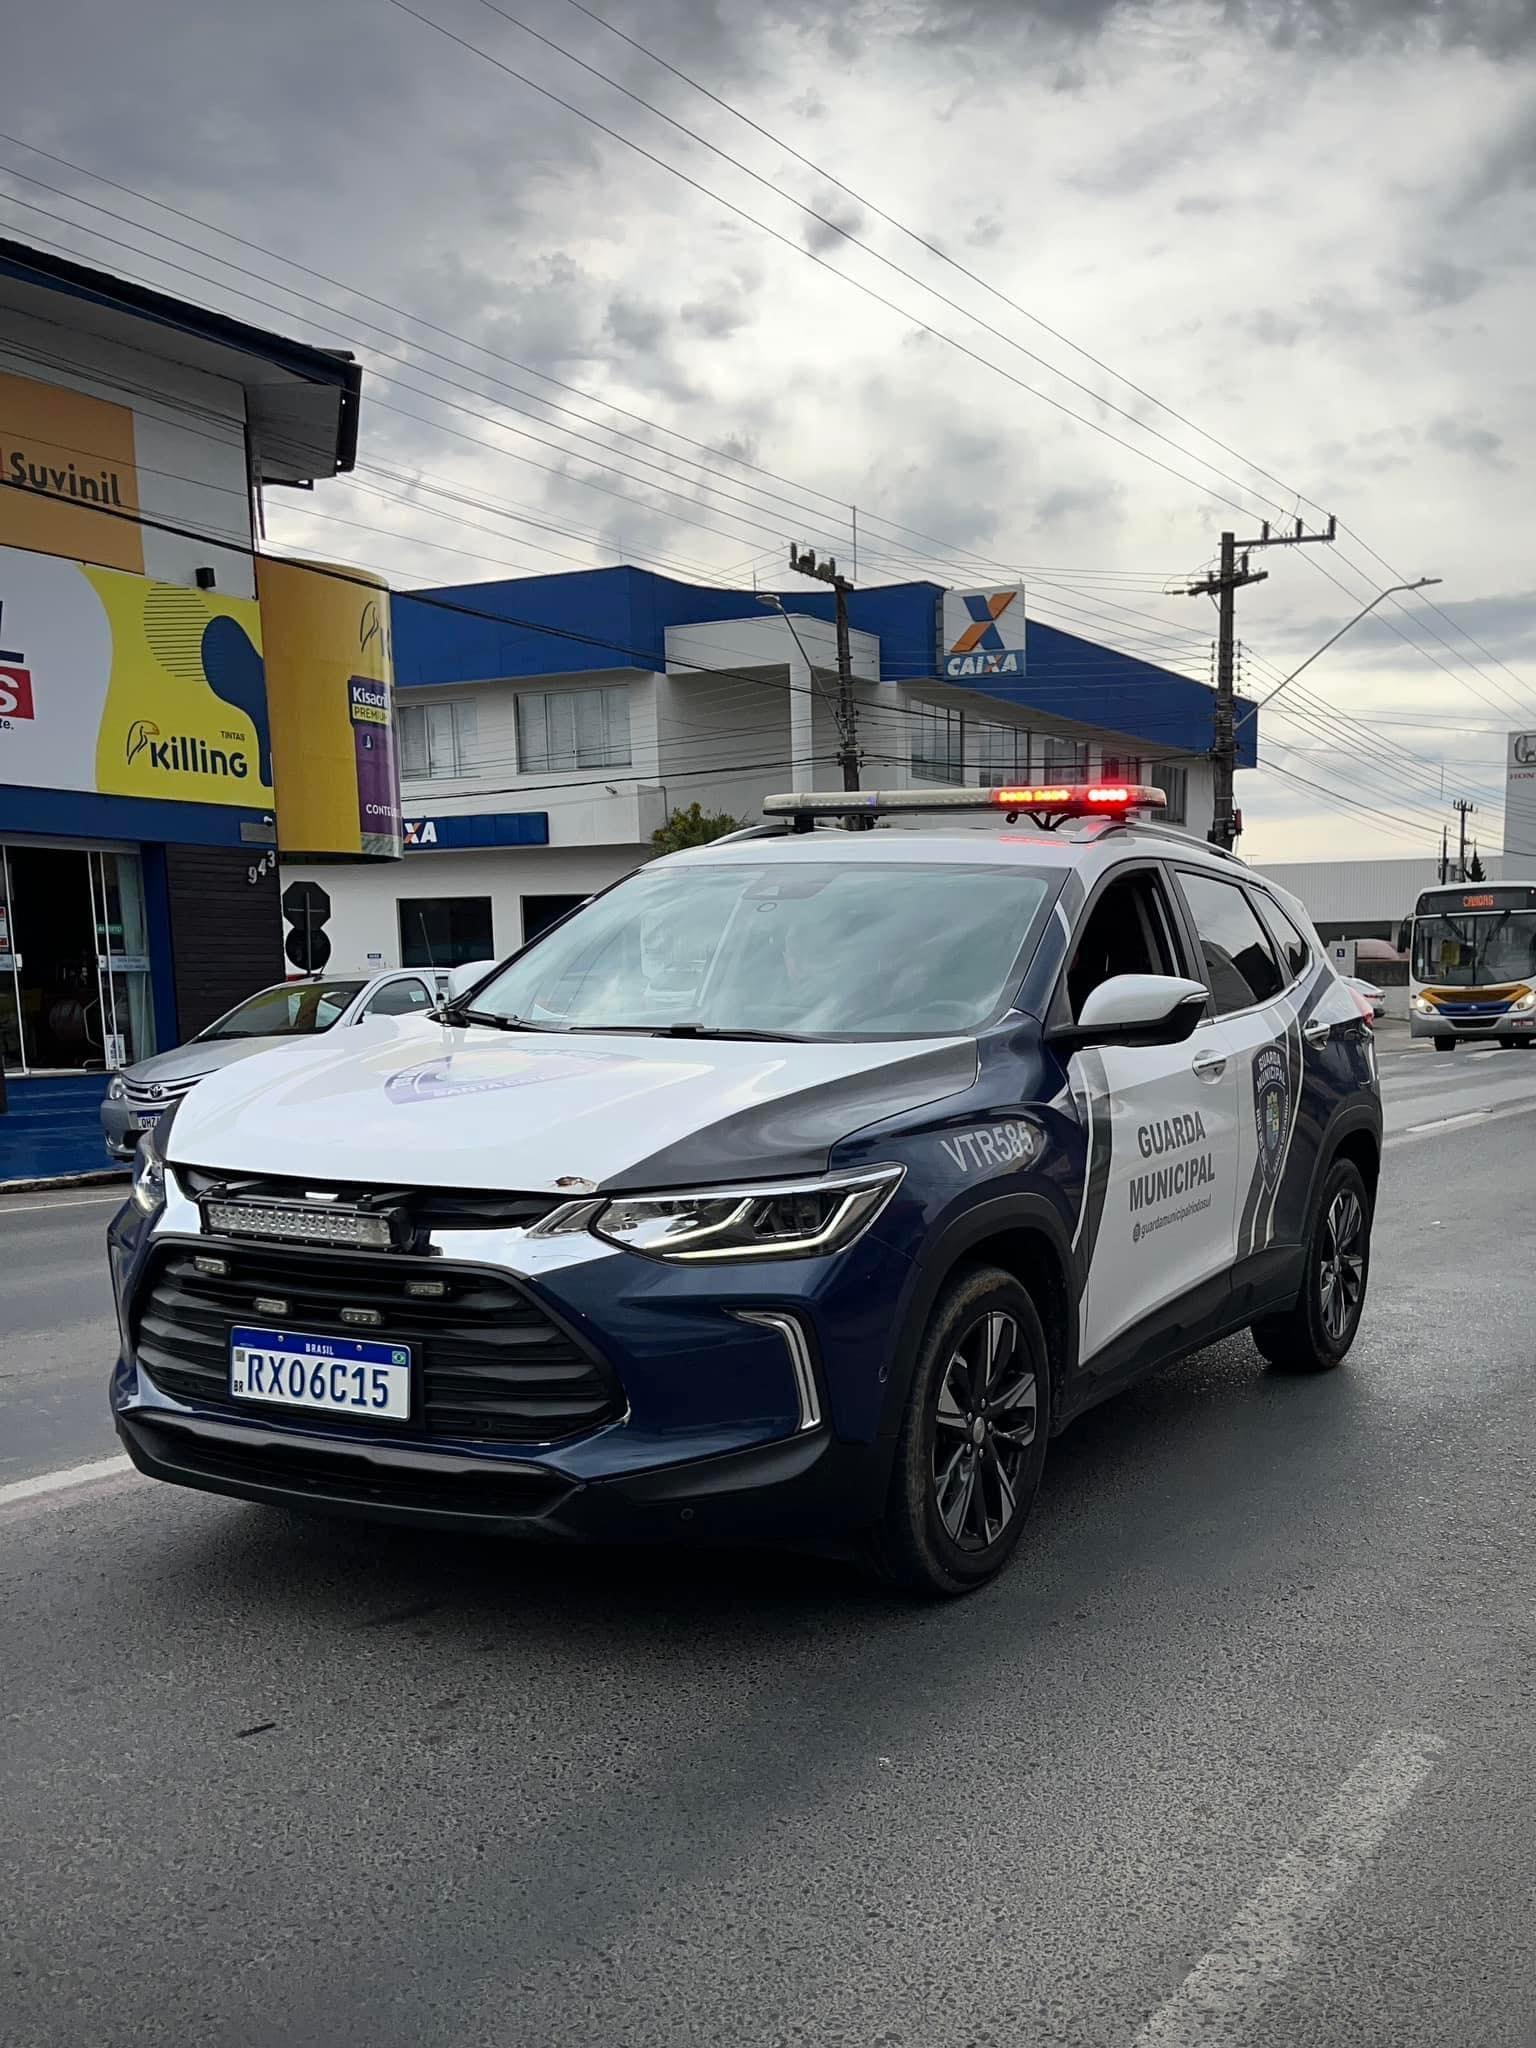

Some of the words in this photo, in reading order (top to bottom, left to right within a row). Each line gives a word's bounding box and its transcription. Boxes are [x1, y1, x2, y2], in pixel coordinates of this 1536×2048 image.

[10, 452, 121, 507] Suvinil
[947, 653, 1018, 676] CAIXA
[220, 730, 246, 742] TINTAS
[247, 850, 276, 885] 943
[1137, 1111, 1206, 1159] GUARDA
[1130, 1152, 1215, 1212] MUNICIPAL
[305, 1343, 334, 1356] BRASIL
